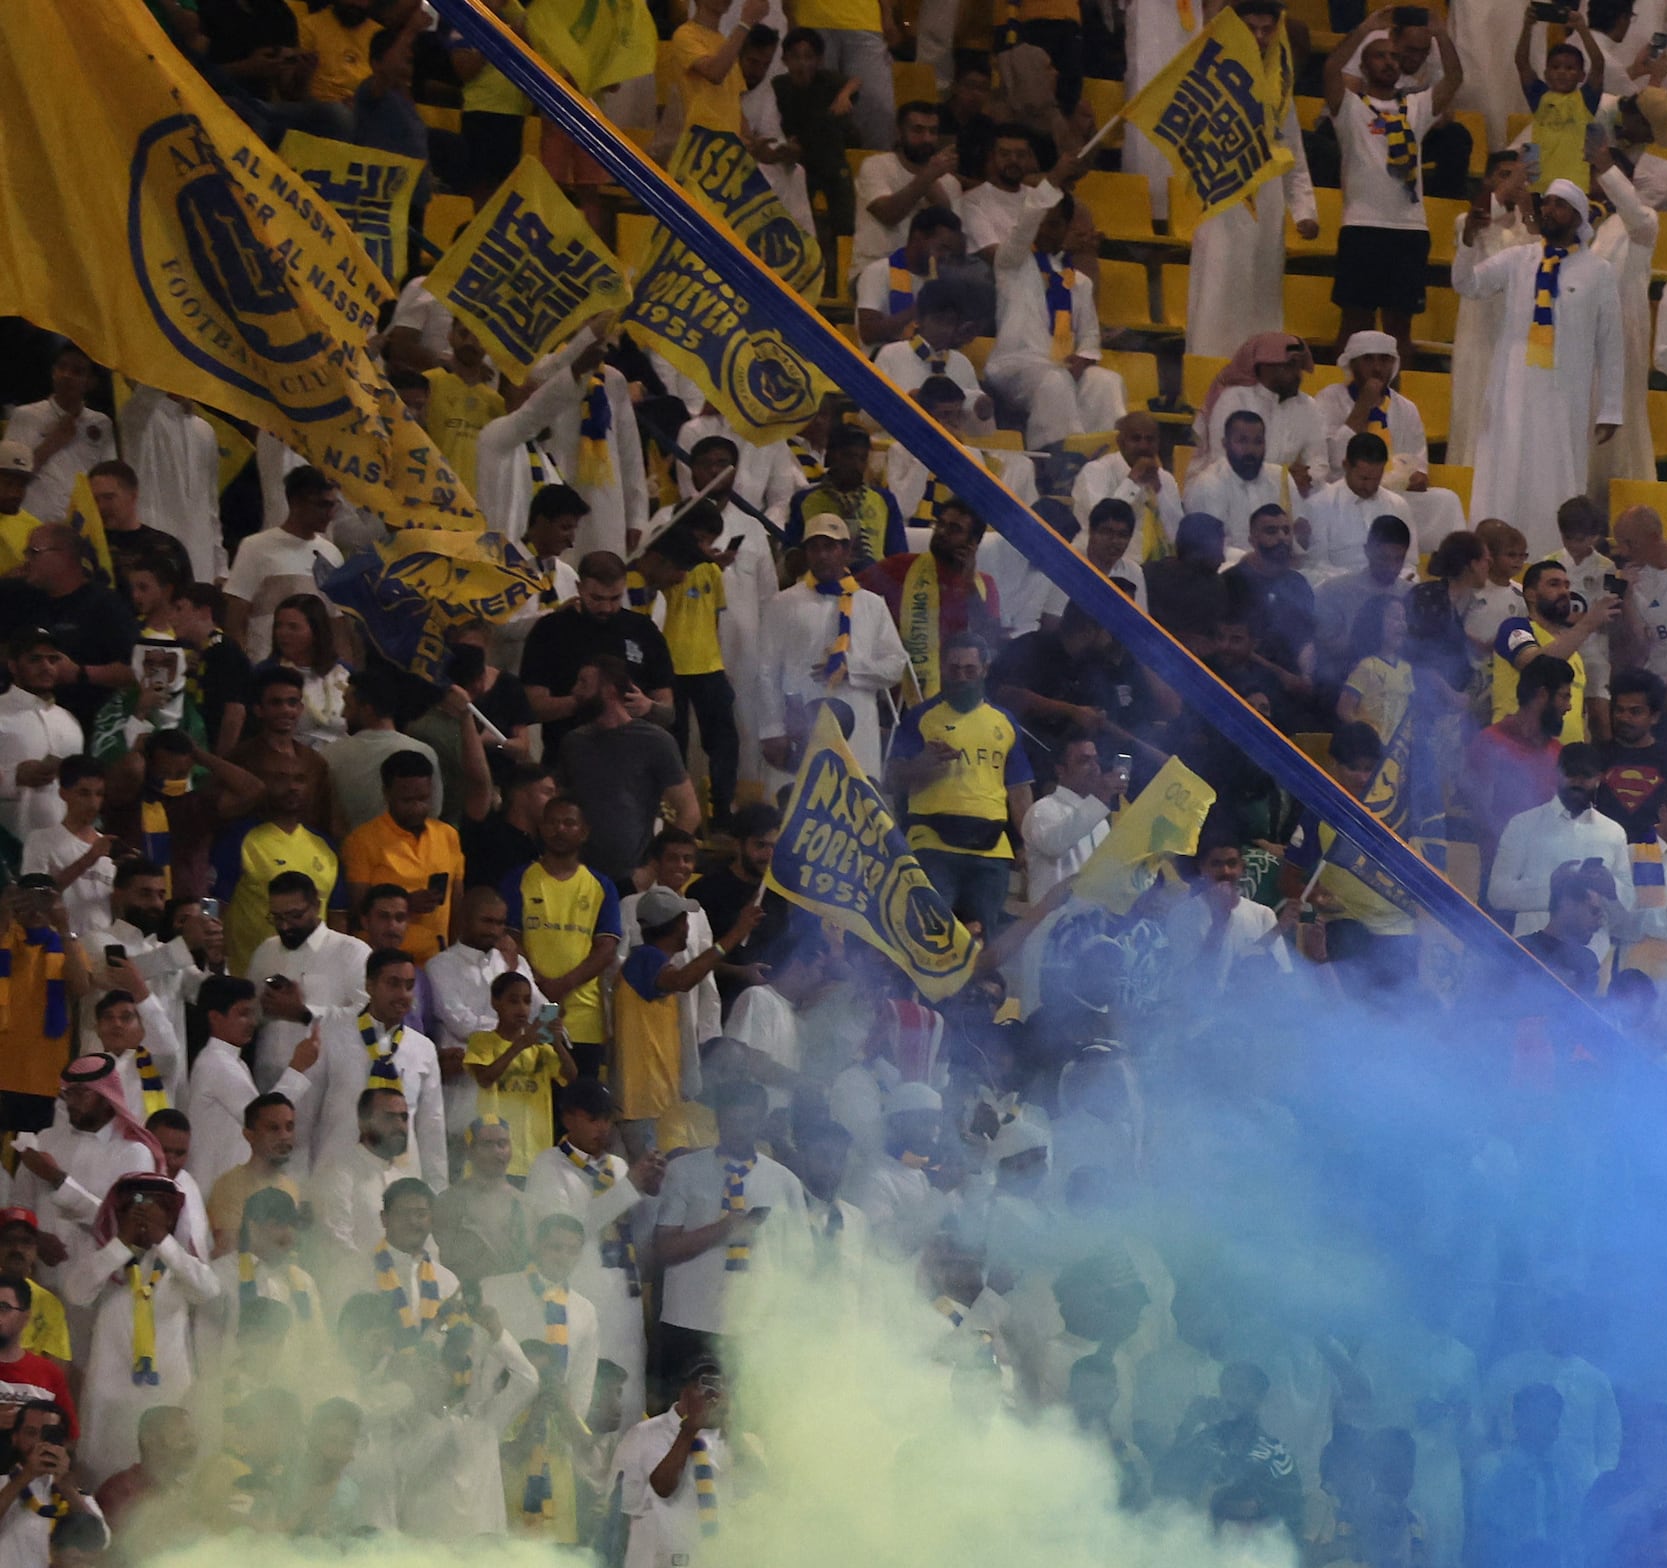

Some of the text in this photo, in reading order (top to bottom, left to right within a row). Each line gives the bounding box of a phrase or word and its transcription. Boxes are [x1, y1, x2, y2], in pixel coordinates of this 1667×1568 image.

[231, 147, 260, 179] AL
[636, 300, 704, 351] 1955
[910, 591, 930, 665] CRISTIANO
